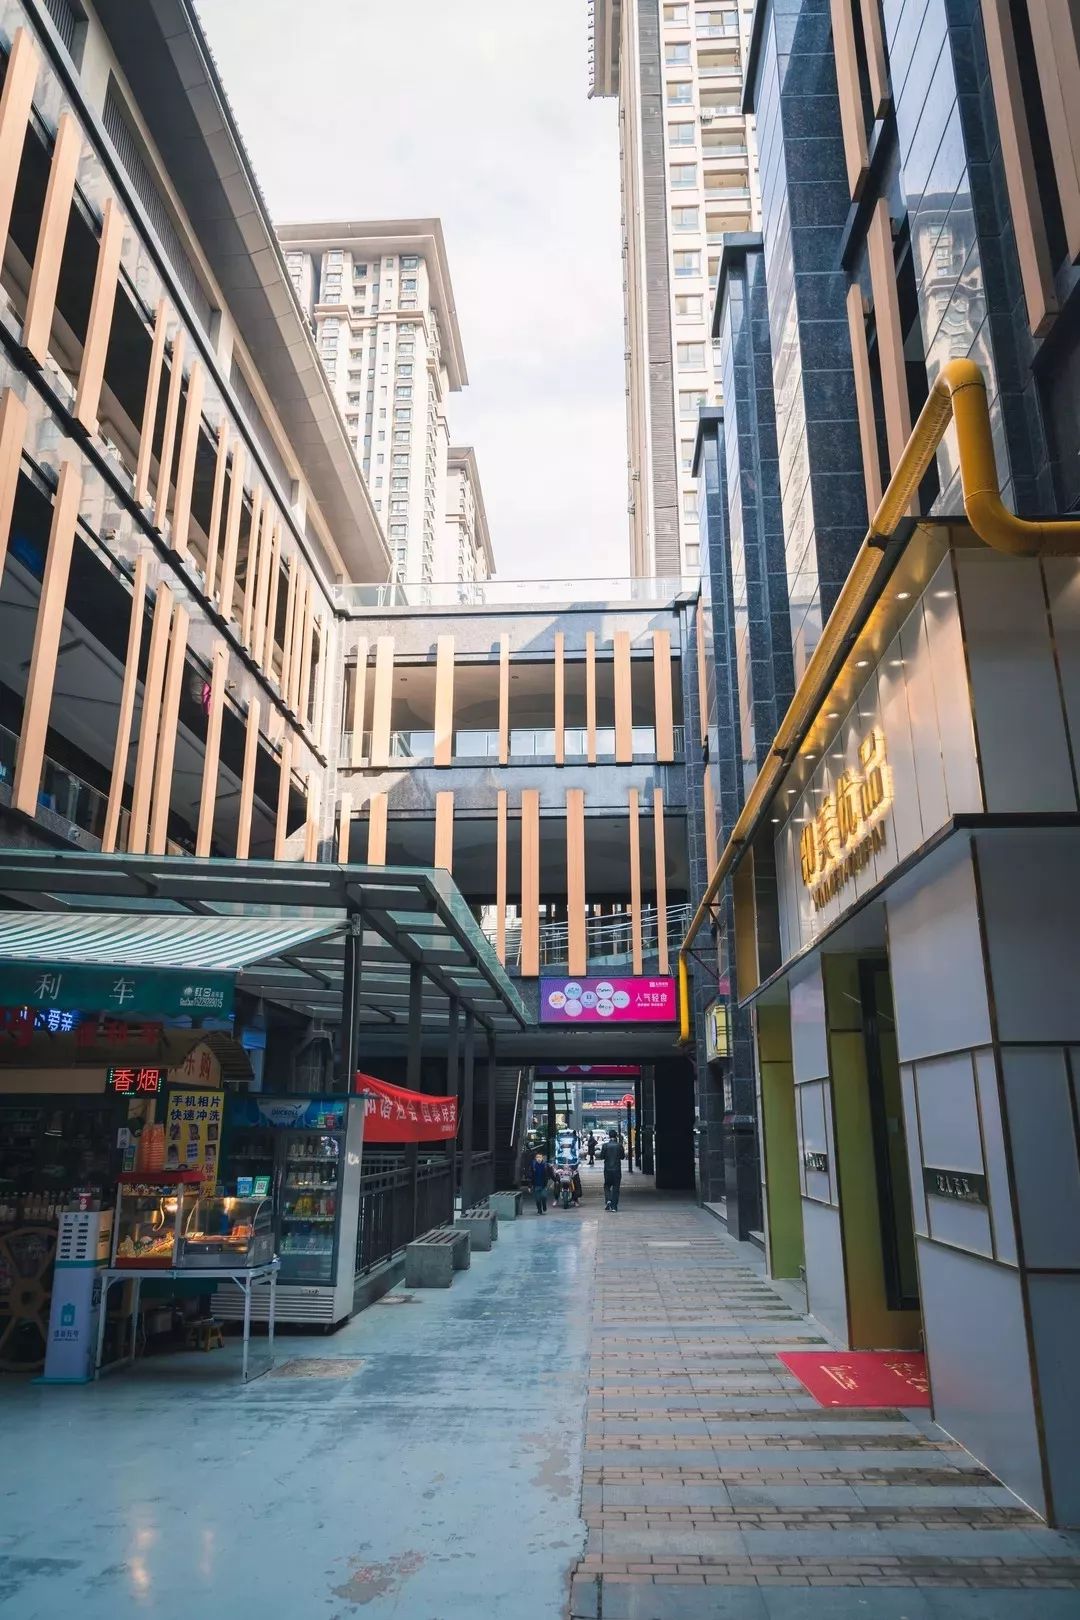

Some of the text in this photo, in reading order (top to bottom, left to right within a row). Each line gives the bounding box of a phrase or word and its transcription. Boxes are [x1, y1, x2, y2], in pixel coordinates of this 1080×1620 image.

[635, 993, 668, 1002] 人气轻食
[112, 1068, 160, 1092] 香烟
[172, 1095, 221, 1106] 手机相片
[170, 1109, 220, 1121] 快速冲洗
